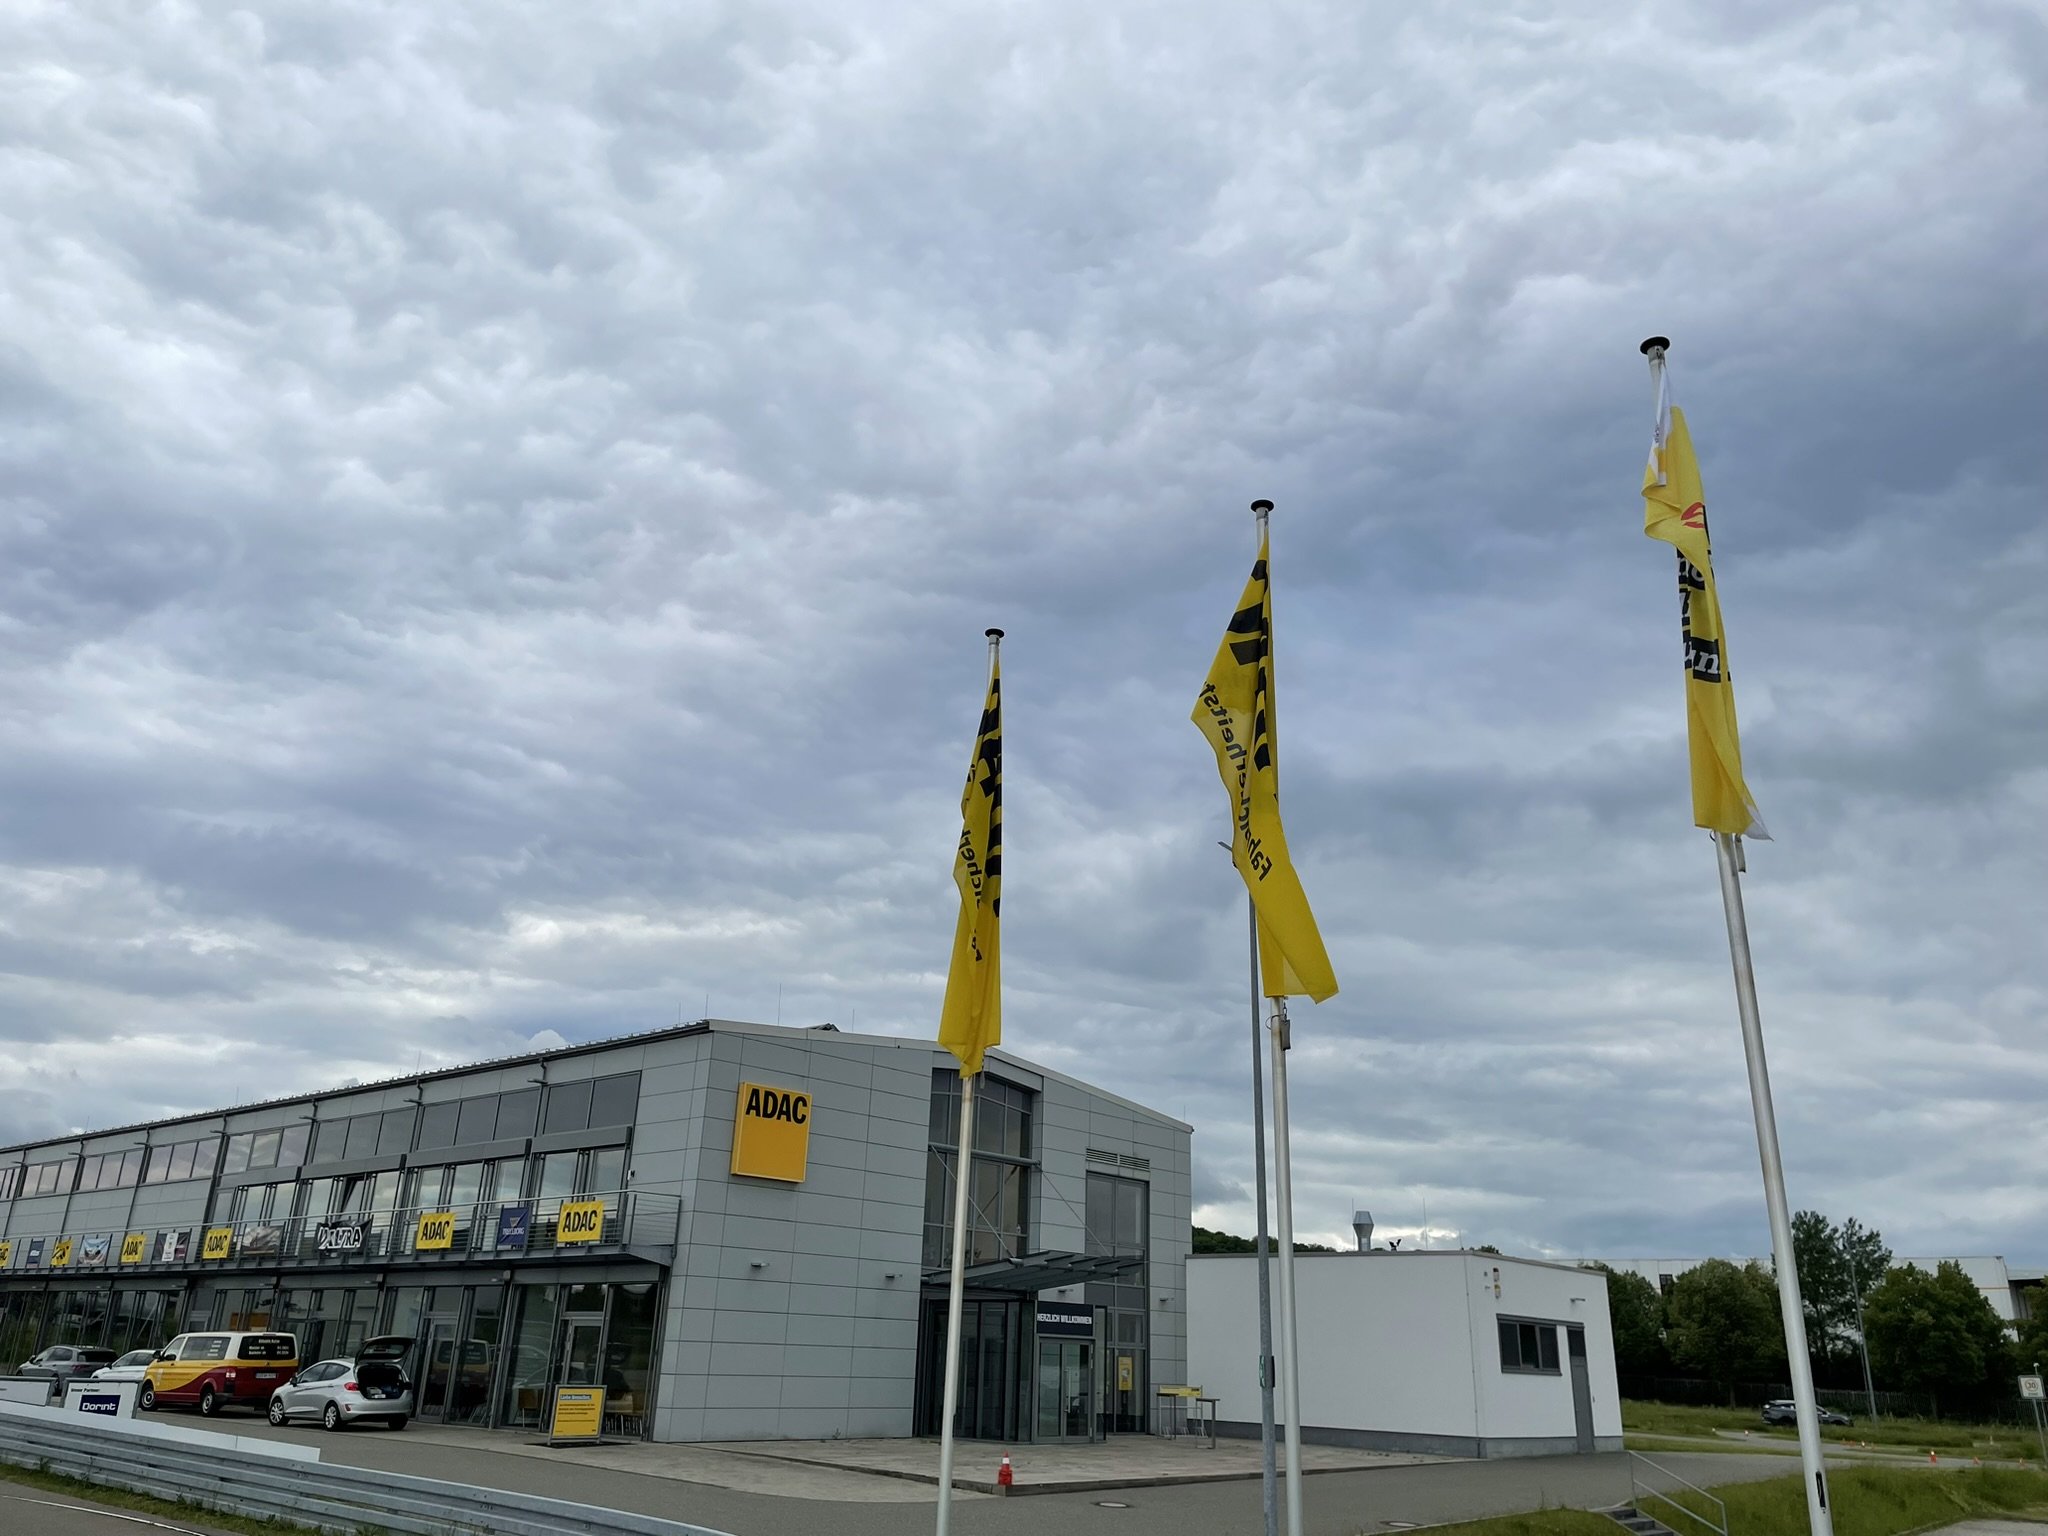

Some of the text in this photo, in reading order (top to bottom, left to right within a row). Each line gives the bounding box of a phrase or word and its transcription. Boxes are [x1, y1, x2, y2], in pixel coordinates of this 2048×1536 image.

[745, 1088, 808, 1125] ADAC
[420, 1220, 450, 1241] ADAC
[562, 1209, 598, 1233] ADAC
[205, 1234, 228, 1252] ADAC
[81, 1402, 116, 1411] Dorint
